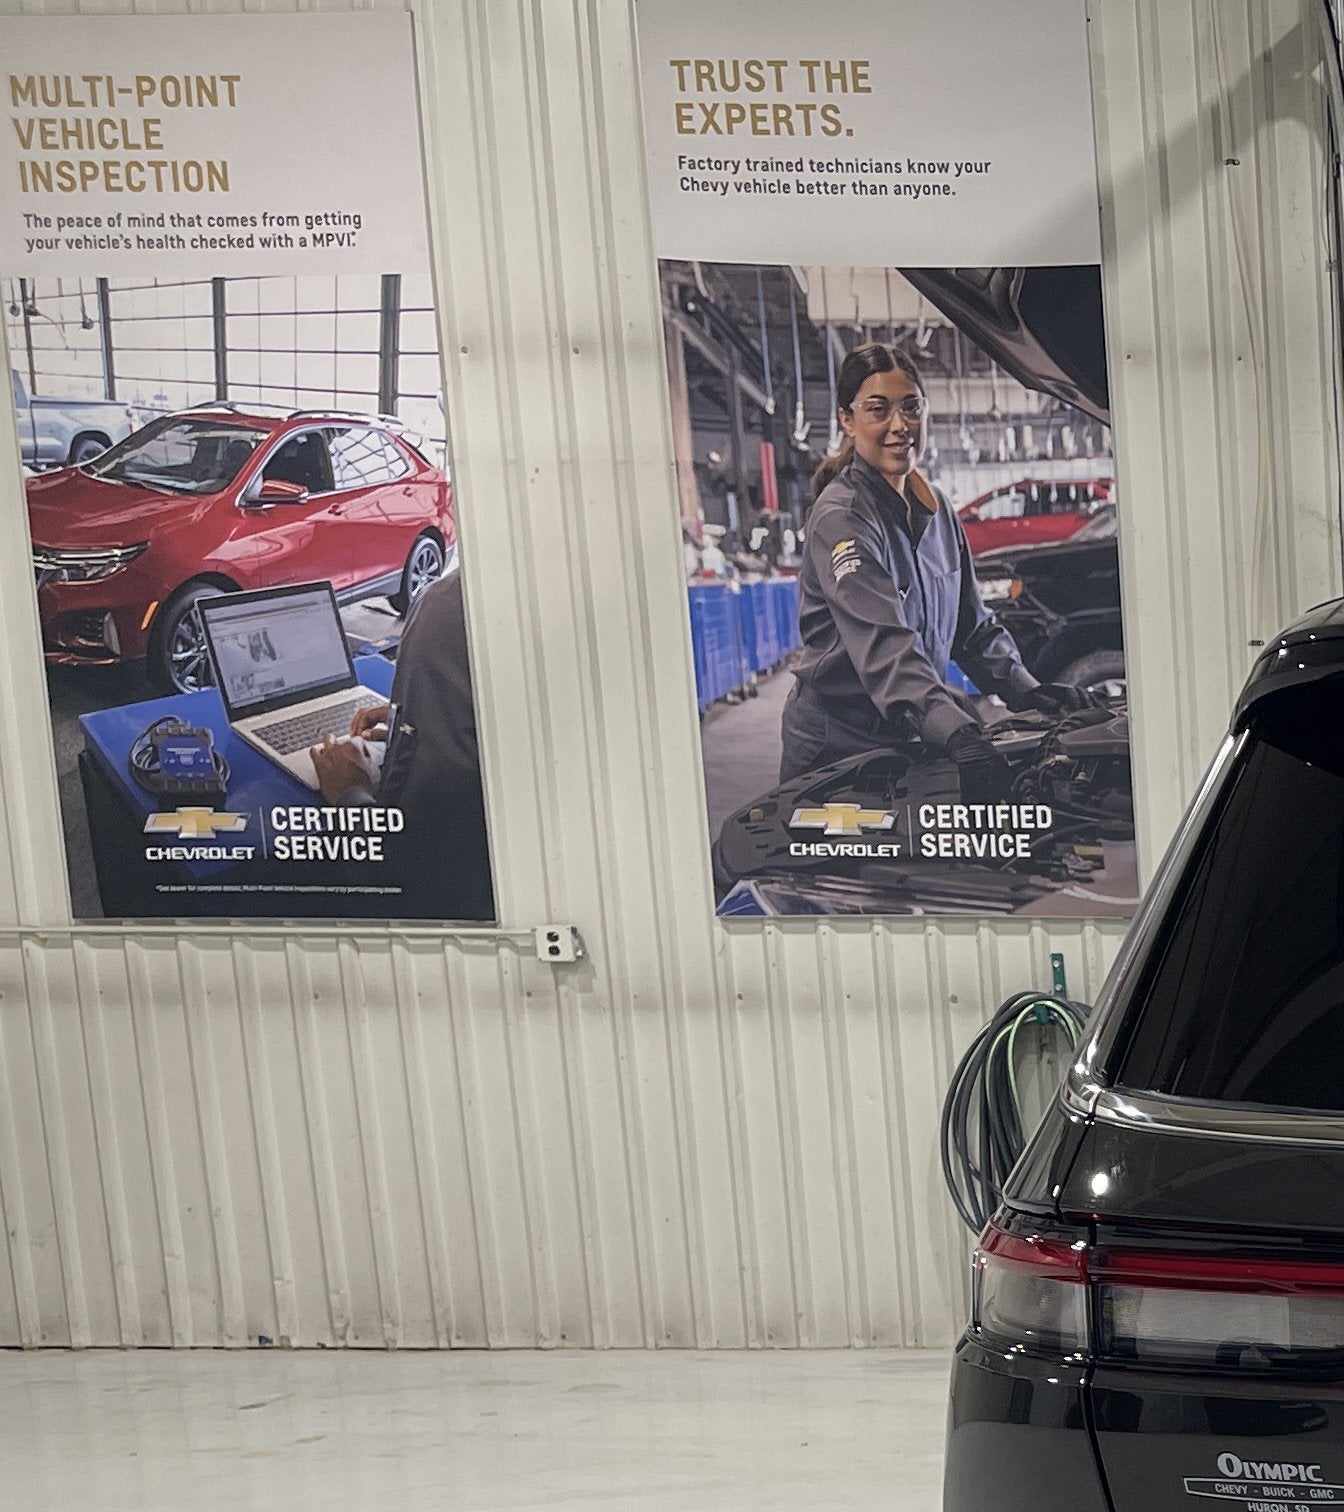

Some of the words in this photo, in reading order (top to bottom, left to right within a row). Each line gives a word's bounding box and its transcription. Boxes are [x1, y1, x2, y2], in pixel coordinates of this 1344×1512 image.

[670, 60, 788, 92] TRUST
[802, 60, 872, 93] THE
[9, 75, 240, 109] MULTI-POINT
[675, 103, 854, 137] EXPERTS.
[13, 118, 164, 150] VEHICLE
[19, 160, 230, 193] INSPECTION
[678, 156, 741, 175] Factory
[745, 157, 804, 174] trained
[809, 157, 902, 175] technicians
[907, 158, 951, 174] know
[955, 160, 991, 177] your
[679, 177, 729, 195] Chevy
[735, 177, 791, 194] vehicle
[795, 178, 846, 195] better
[851, 178, 888, 196] than
[893, 181, 957, 199] anyone.
[23, 214, 52, 229] The
[57, 217, 102, 232] peace
[106, 212, 123, 228] of
[127, 213, 165, 228] mind
[169, 212, 202, 228] that
[207, 215, 257, 228] comes
[262, 211, 300, 227] from
[305, 211, 362, 232] getting
[26, 234, 61, 253] your
[65, 233, 132, 250] vehicle's
[136, 233, 186, 249] health
[190, 232, 255, 249] checked
[259, 232, 295, 248] with
[299, 236, 308, 248] a
[271, 807, 404, 832] CERTIFIED
[919, 804, 1052, 829] CERTIFIED
[145, 847, 255, 861] CHEVROLET
[273, 836, 384, 862] SERVICE
[789, 842, 901, 857] CHEVROLET
[921, 834, 1031, 858] SERVICE
[1215, 1483, 1248, 1495] CHEVY
[1262, 1485, 1295, 1498] BUICK
[1309, 1487, 1335, 1499] GMC
